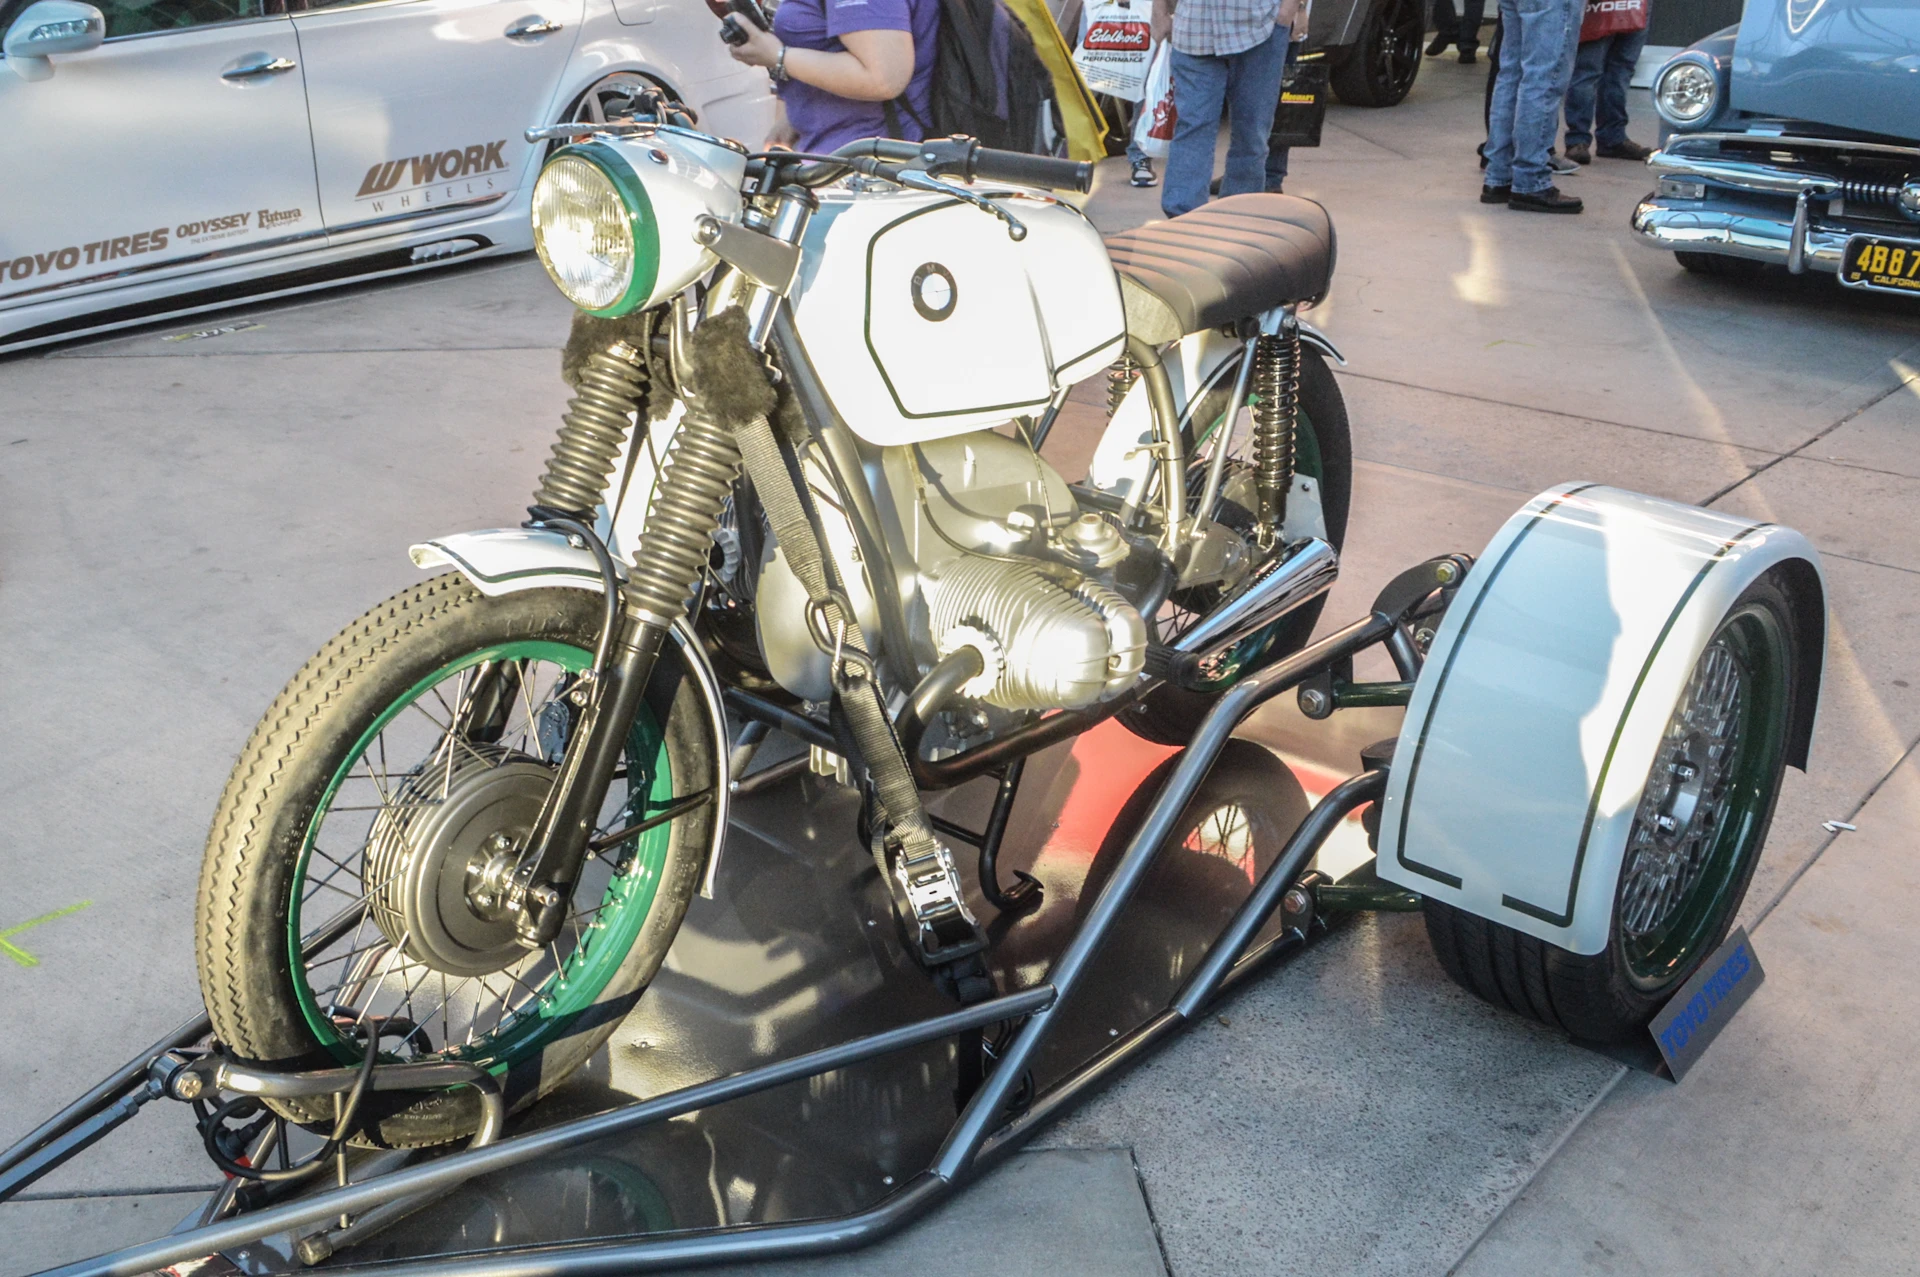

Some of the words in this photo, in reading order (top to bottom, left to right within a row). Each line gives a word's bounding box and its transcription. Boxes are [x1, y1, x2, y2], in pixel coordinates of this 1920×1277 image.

[411, 139, 507, 186] WORK
[371, 177, 494, 213] WHEELS
[176, 211, 251, 238] ODYSSEY
[258, 208, 302, 228] Futura
[83, 227, 169, 265] TIRES
[1661, 991, 1709, 1058] TOYO
